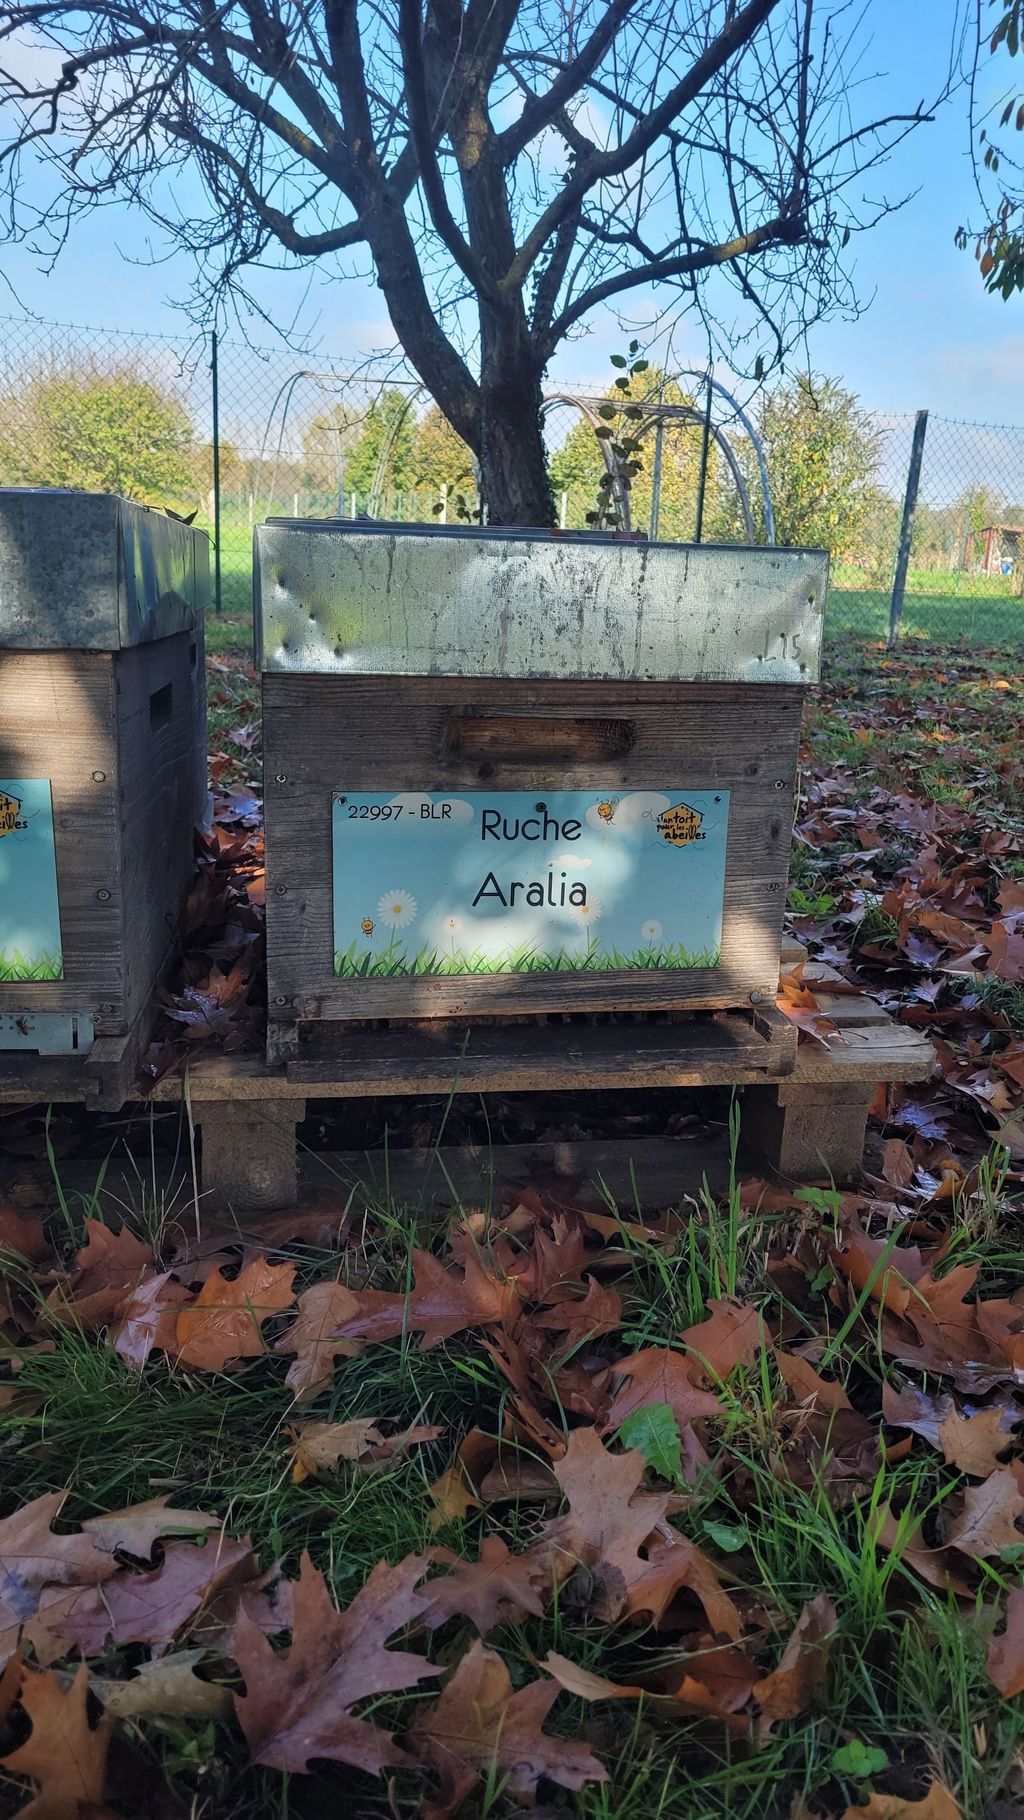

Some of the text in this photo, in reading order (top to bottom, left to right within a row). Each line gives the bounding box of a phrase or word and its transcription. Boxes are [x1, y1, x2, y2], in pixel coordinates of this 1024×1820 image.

[348, 805, 404, 821] 22997
[420, 804, 452, 819] BLR
[673, 812, 696, 823] toit
[481, 809, 582, 841] Ruche
[656, 824, 674, 832] pour
[664, 825, 706, 840] abeilles
[472, 871, 587, 907] Aralia
